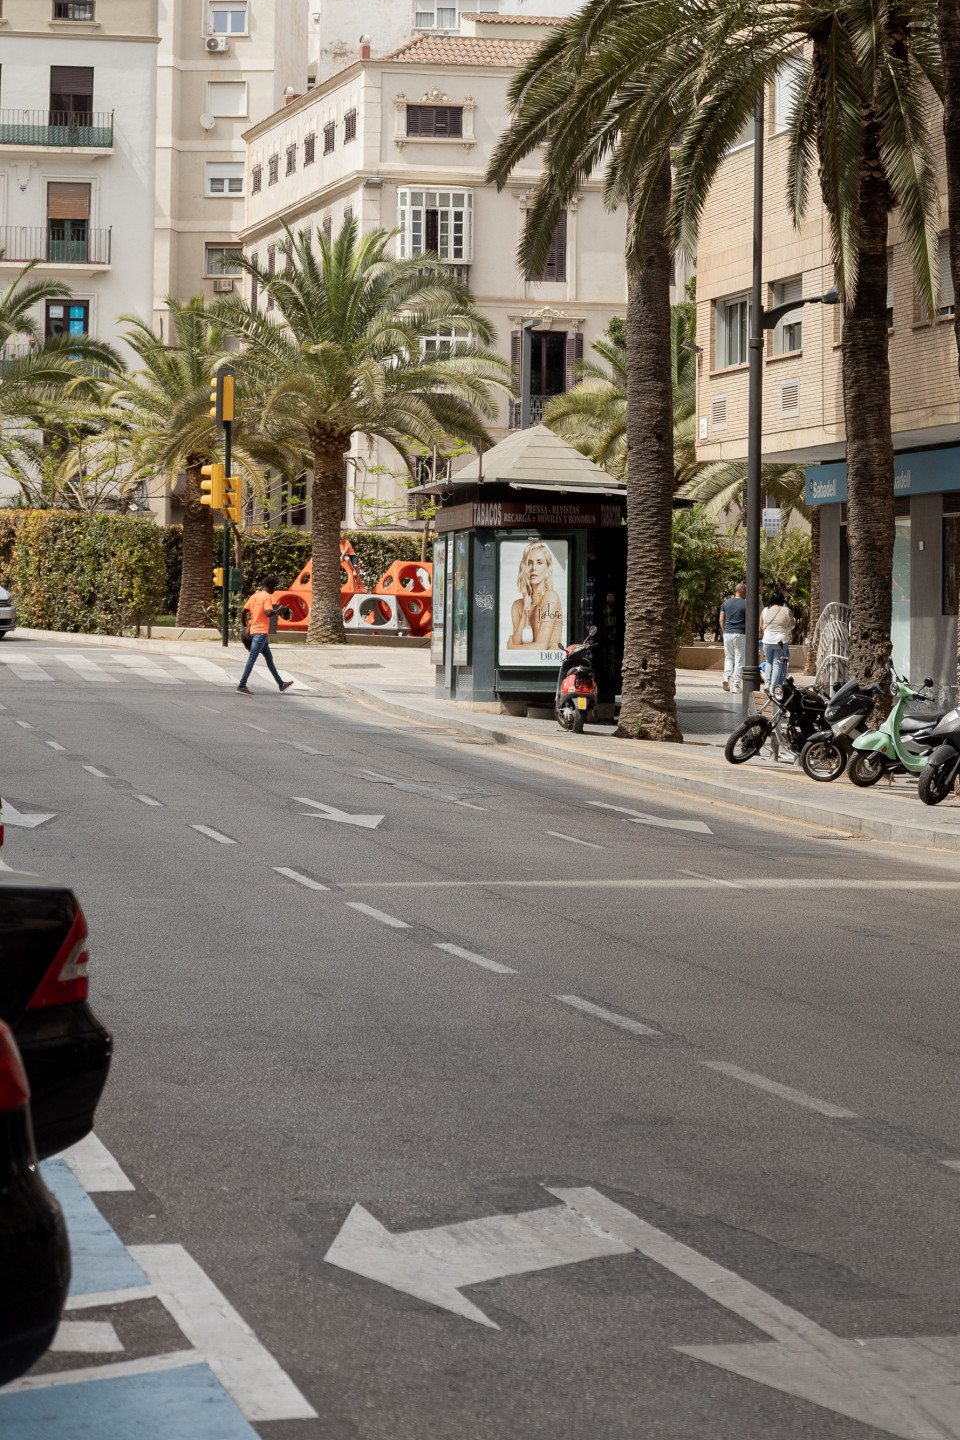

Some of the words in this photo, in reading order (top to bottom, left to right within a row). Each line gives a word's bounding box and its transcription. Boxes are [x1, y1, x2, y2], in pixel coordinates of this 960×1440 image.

[813, 479, 837, 499] Sabadell
[473, 503, 502, 526] TABACOS
[525, 504, 548, 513] PRENSA
[552, 505, 580, 515] REVISTAS
[503, 513, 531, 522] RECARGA
[563, 514, 568, 524] Y
[568, 514, 596, 524] BONOBUS
[540, 651, 563, 661] DIOR
